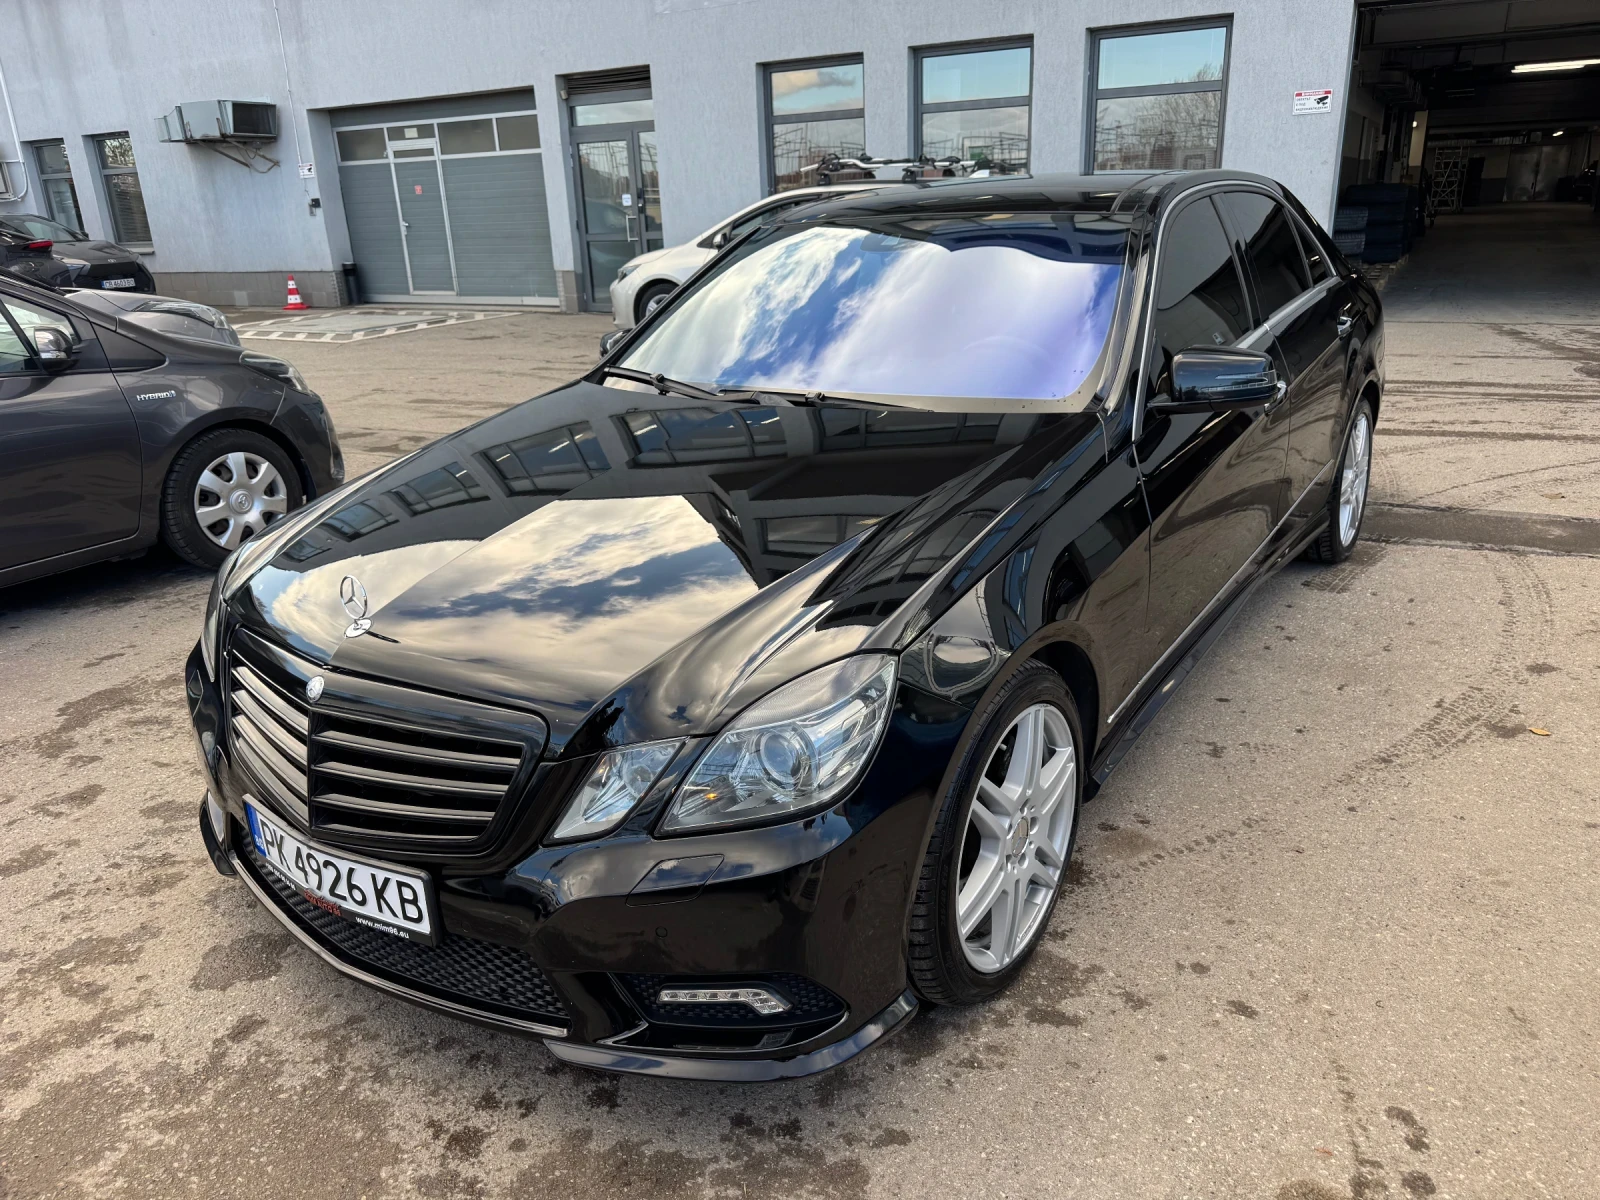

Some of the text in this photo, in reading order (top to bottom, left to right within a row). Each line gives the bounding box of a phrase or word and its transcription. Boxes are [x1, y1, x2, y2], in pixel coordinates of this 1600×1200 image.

[136, 391, 170, 401] HYBRID
[260, 818, 293, 874] PK
[295, 845, 367, 907] 4926
[370, 872, 423, 924] KB
